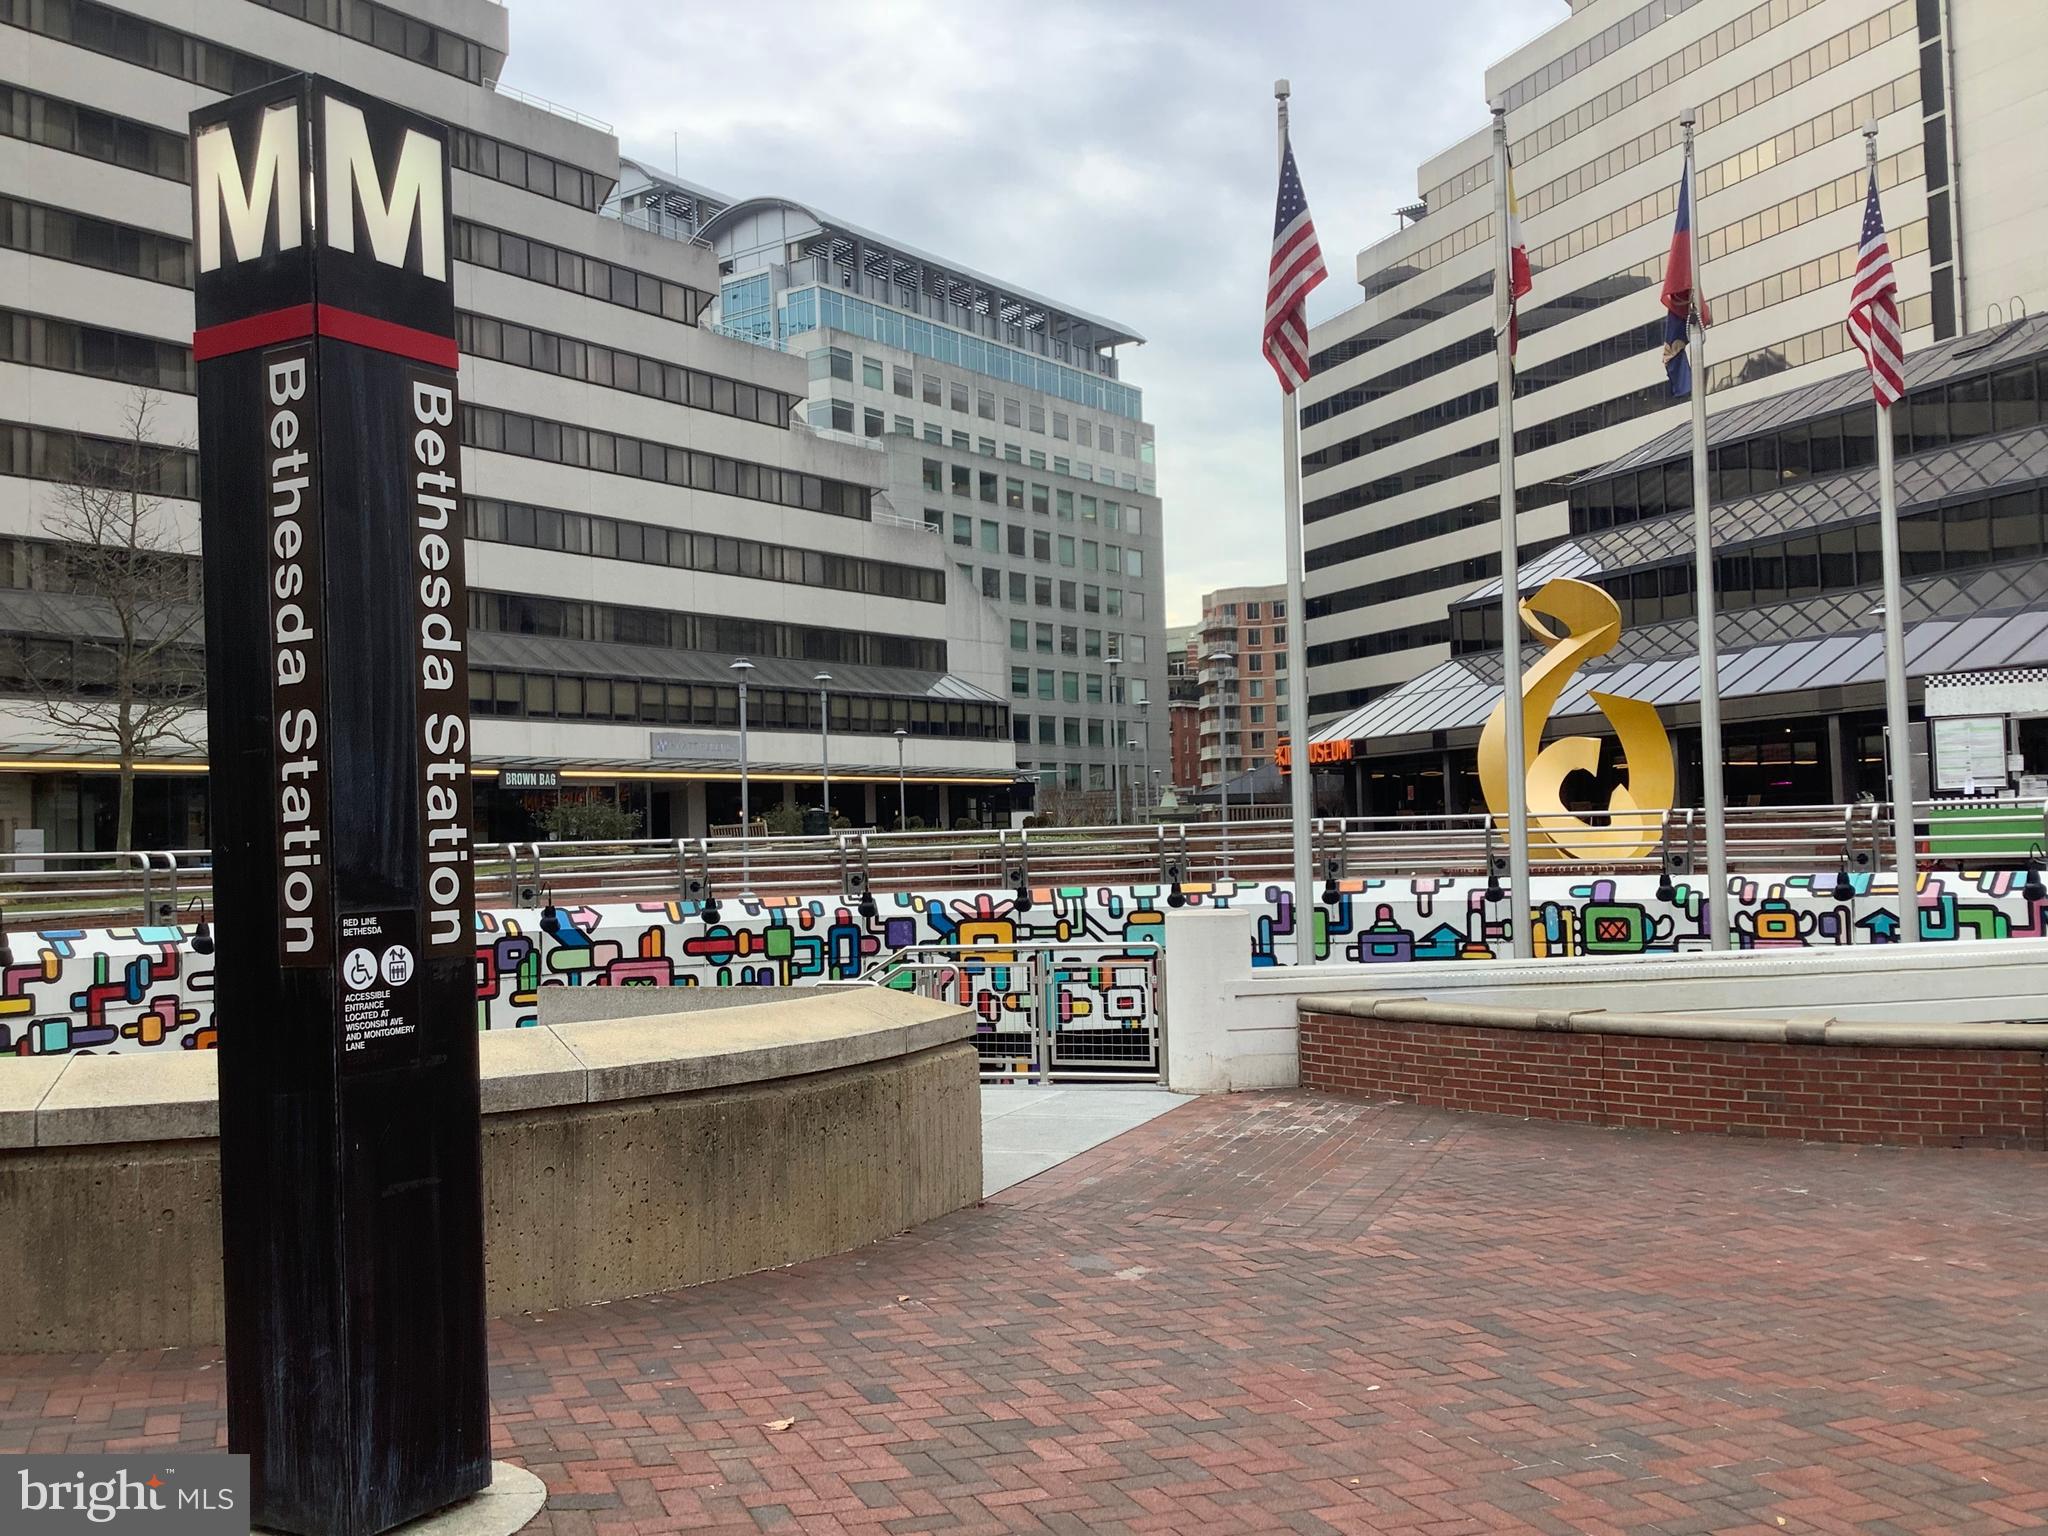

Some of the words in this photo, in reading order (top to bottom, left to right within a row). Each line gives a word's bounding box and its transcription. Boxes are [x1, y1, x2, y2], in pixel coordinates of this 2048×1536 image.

[197, 93, 302, 274] M
[325, 95, 446, 283] M
[269, 357, 314, 687] Bethesda
[413, 381, 462, 691] Bethesda
[1307, 739, 1353, 763] USEUM
[505, 772, 537, 786] BROWN
[539, 773, 556, 786] BAG
[279, 708, 321, 953] Station
[425, 713, 468, 945] Station
[343, 918, 359, 927] RED
[360, 917, 377, 926] LINE
[343, 926, 382, 937] BETHESDA
[345, 990, 391, 1003] ACCESSIBLE
[345, 1001, 385, 1012] ENTRANCE
[345, 1011, 379, 1023] LOCATED
[380, 1009, 390, 1018] AT
[345, 1019, 388, 1032] WISCONSIN
[389, 1017, 404, 1026] AVE
[345, 1032, 362, 1042] AND
[364, 1025, 416, 1039] MONTGOMERY
[345, 1041, 366, 1052] LANE
